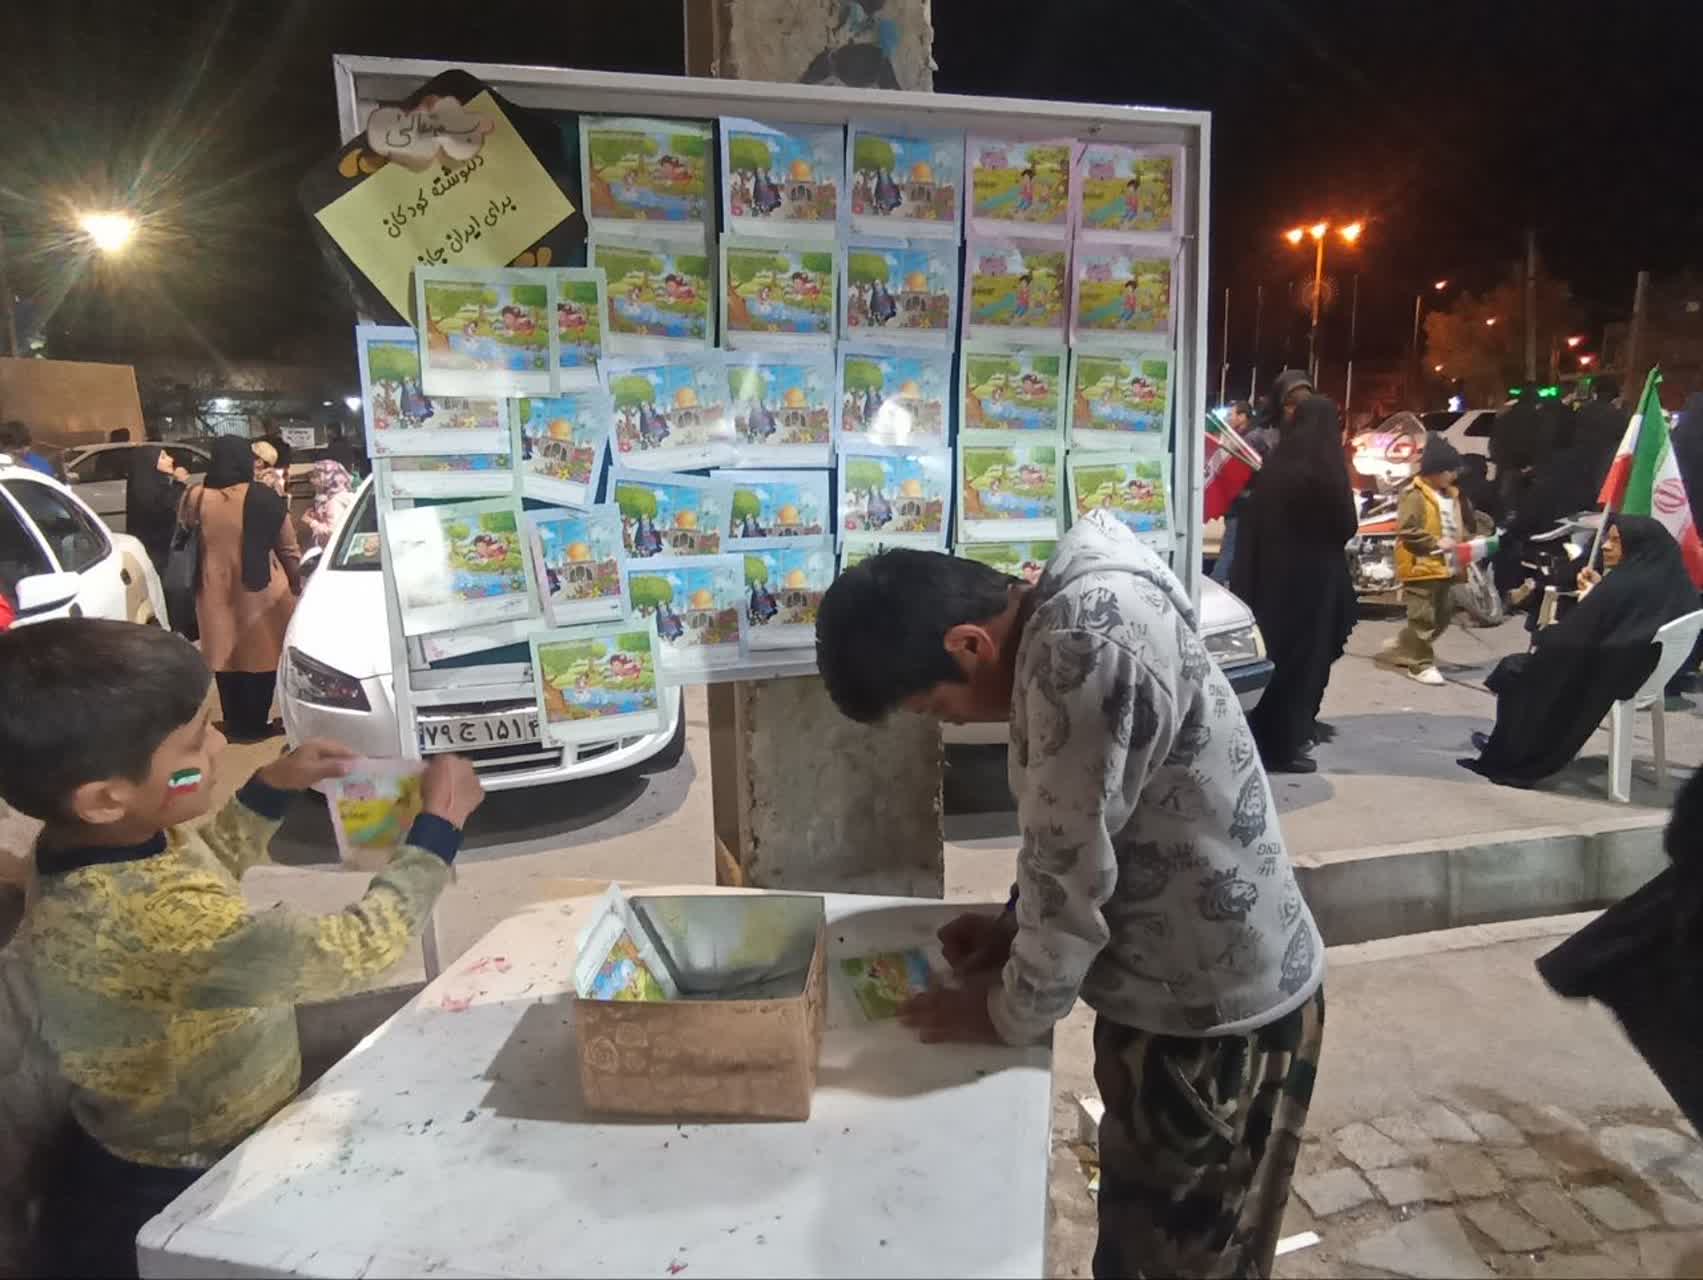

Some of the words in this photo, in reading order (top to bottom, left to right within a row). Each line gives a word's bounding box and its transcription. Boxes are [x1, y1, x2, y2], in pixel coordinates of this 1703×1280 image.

[383, 187, 428, 238] کودکان
[484, 196, 517, 227] برای
[446, 215, 481, 253] ایران
[459, 721, 478, 742] ج
[484, 718, 522, 741] ۱۵۱
